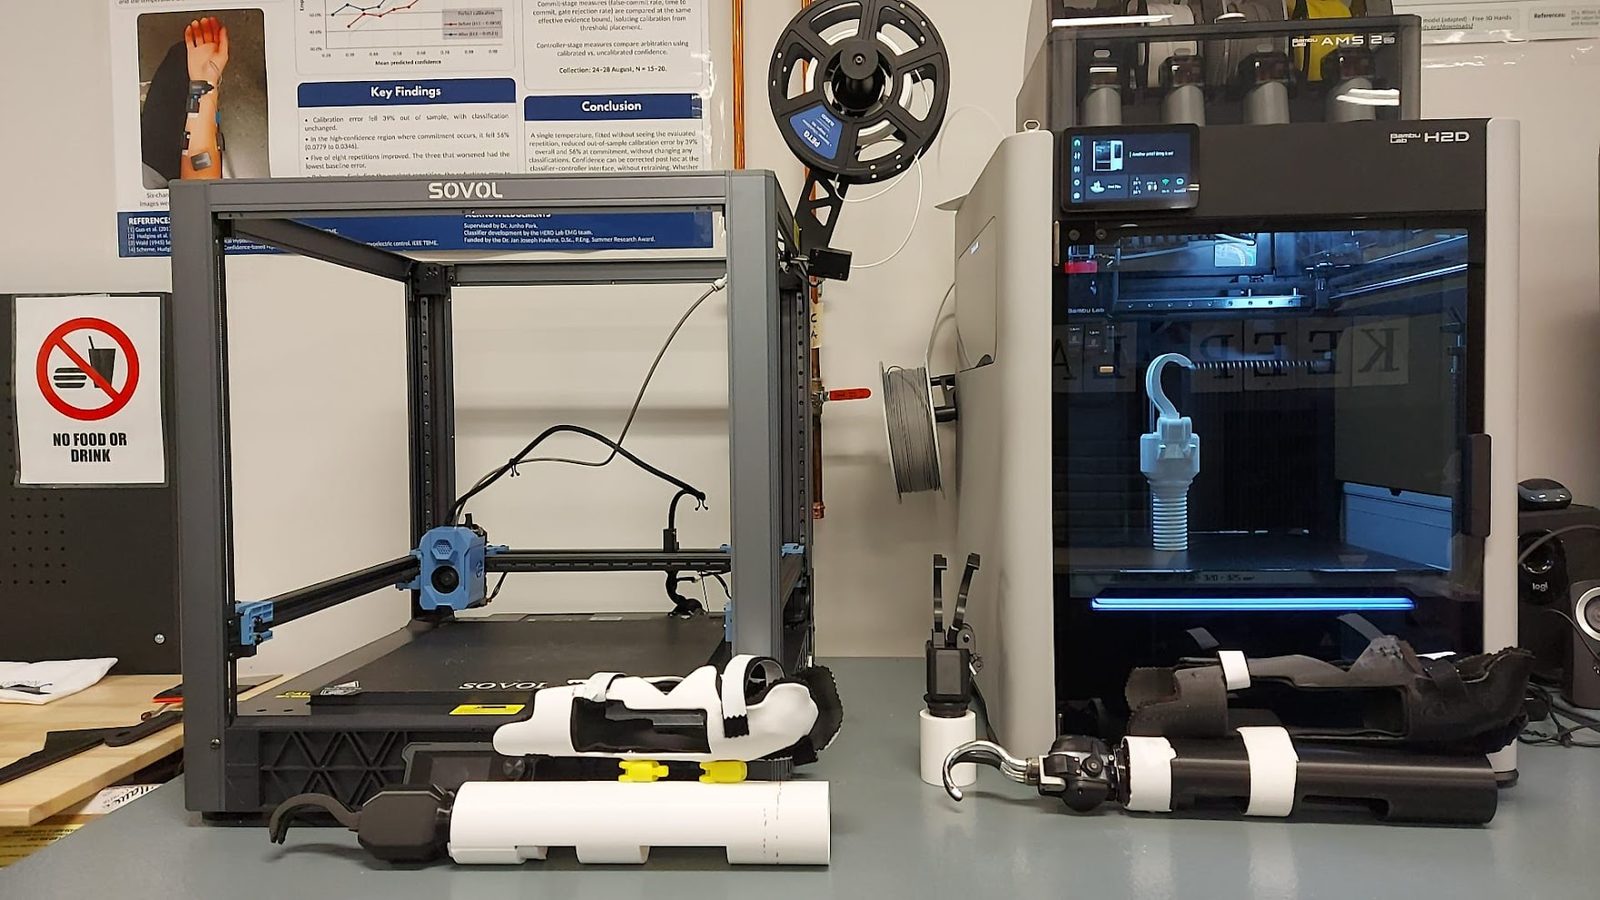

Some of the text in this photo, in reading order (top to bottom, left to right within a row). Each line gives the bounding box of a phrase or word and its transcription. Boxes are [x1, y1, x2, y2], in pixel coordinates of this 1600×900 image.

[1321, 35, 1364, 46] AMS
[1370, 35, 1382, 44] 2
[371, 86, 442, 100] Key Findings
[582, 100, 642, 112] Conclusion
[1424, 132, 1470, 142] H2D
[428, 182, 503, 199] SOVOL
[53, 432, 127, 446] NO FOOD OR
[71, 449, 111, 462] DRINK
[1532, 581, 1548, 592] logi
